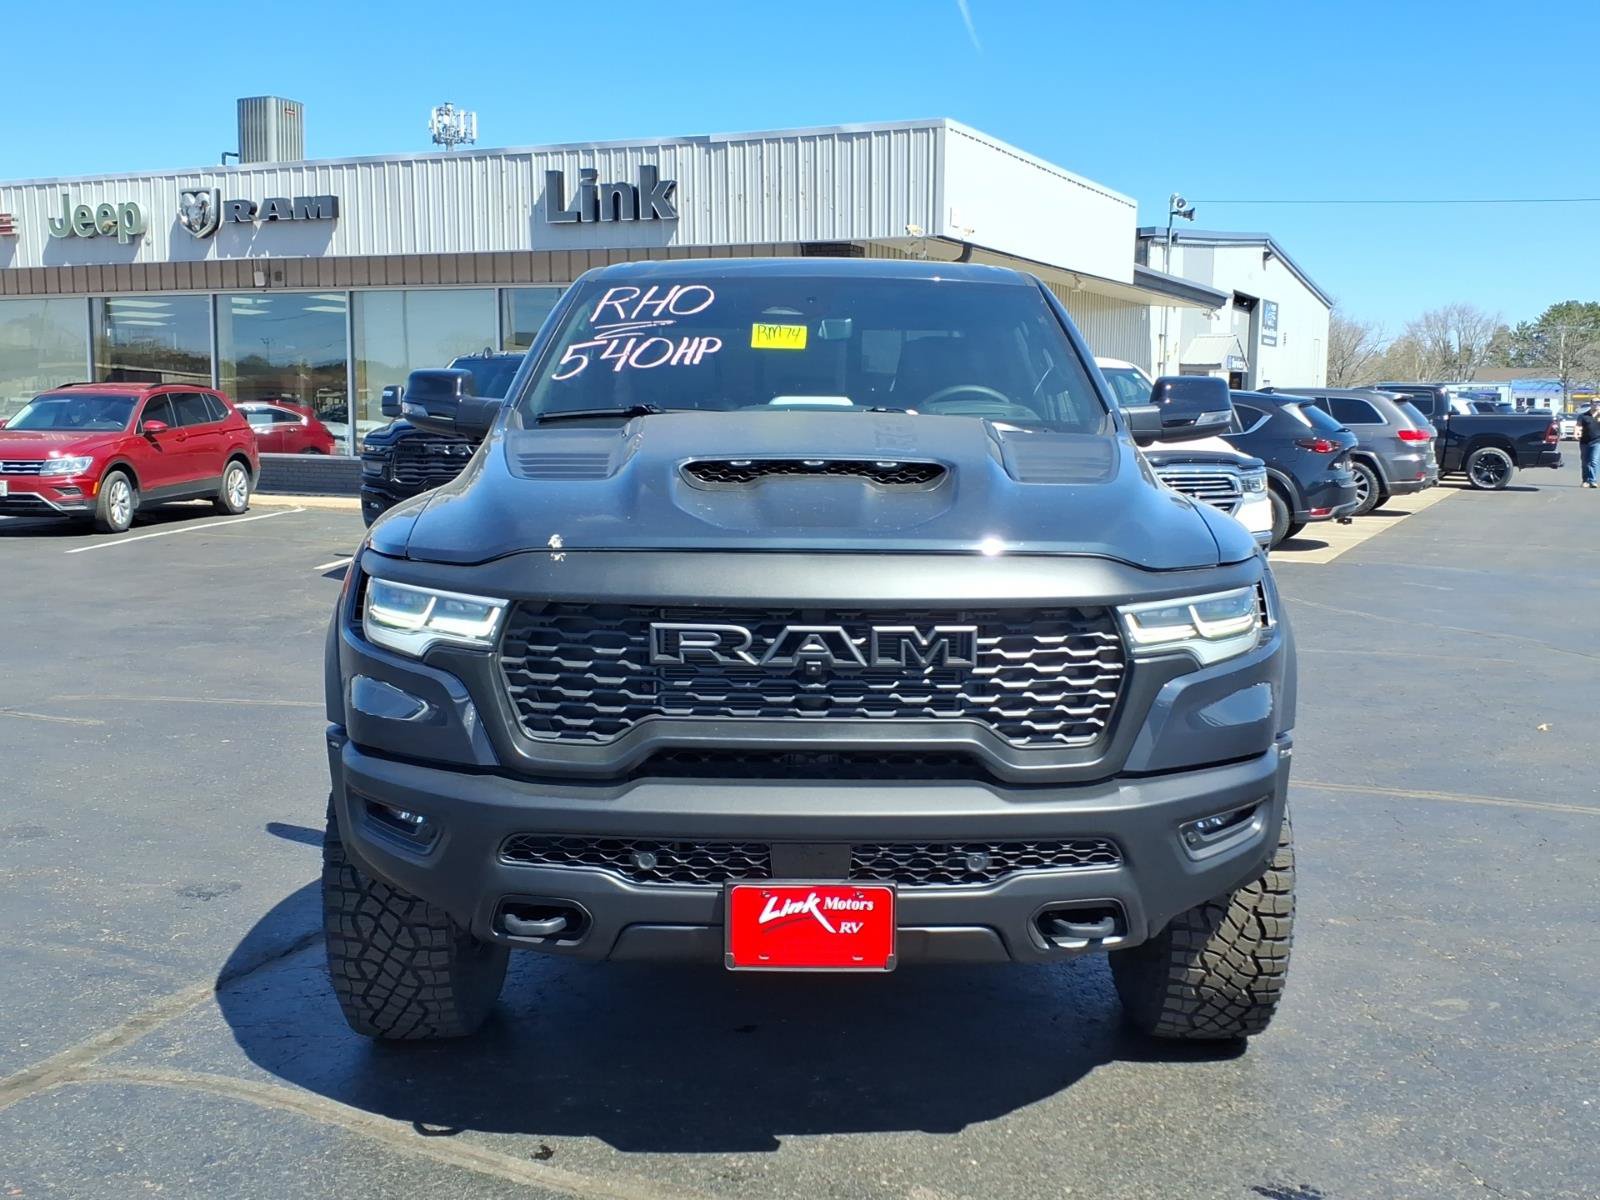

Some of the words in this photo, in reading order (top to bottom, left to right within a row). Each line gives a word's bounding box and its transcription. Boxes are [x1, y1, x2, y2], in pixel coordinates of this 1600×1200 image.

[223, 195, 339, 223] RAM
[545, 165, 679, 223] Link
[49, 194, 147, 244] Jeep
[590, 285, 715, 322] RHO
[649, 622, 978, 668] RAM
[758, 892, 837, 934] Link
[823, 896, 874, 911] Motors
[838, 921, 864, 934] RV
